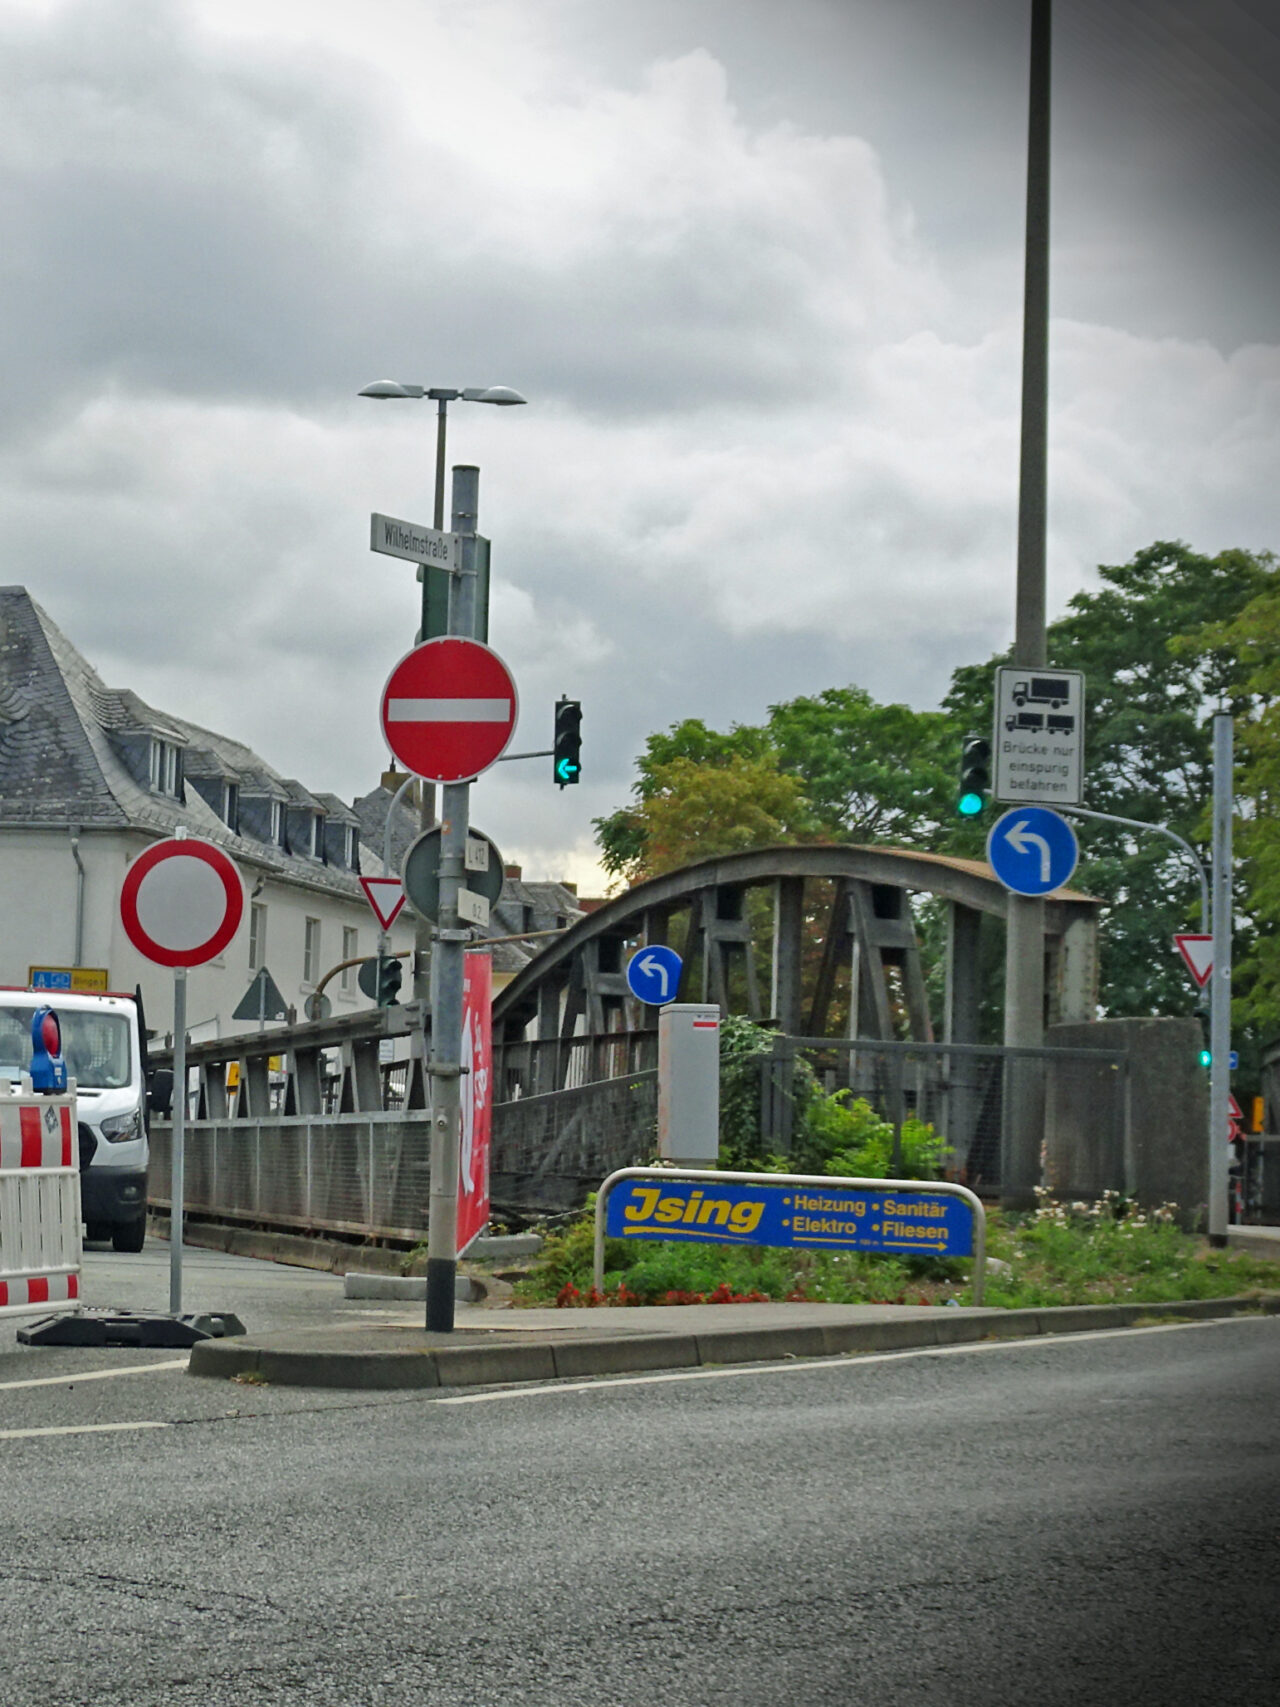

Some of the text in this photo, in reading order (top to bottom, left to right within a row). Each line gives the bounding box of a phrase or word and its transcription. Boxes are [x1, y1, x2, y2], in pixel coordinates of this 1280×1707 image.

[384, 521, 449, 561] Wilhelmstraße
[1003, 740, 1075, 756] Brücke nur
[1009, 761, 1069, 777] einspurig
[1009, 779, 1068, 792] befahren
[624, 1187, 766, 1234] Jsing
[793, 1195, 948, 1218] Heizung Sanitär
[792, 1216, 949, 1239] Elektro Fliesen
